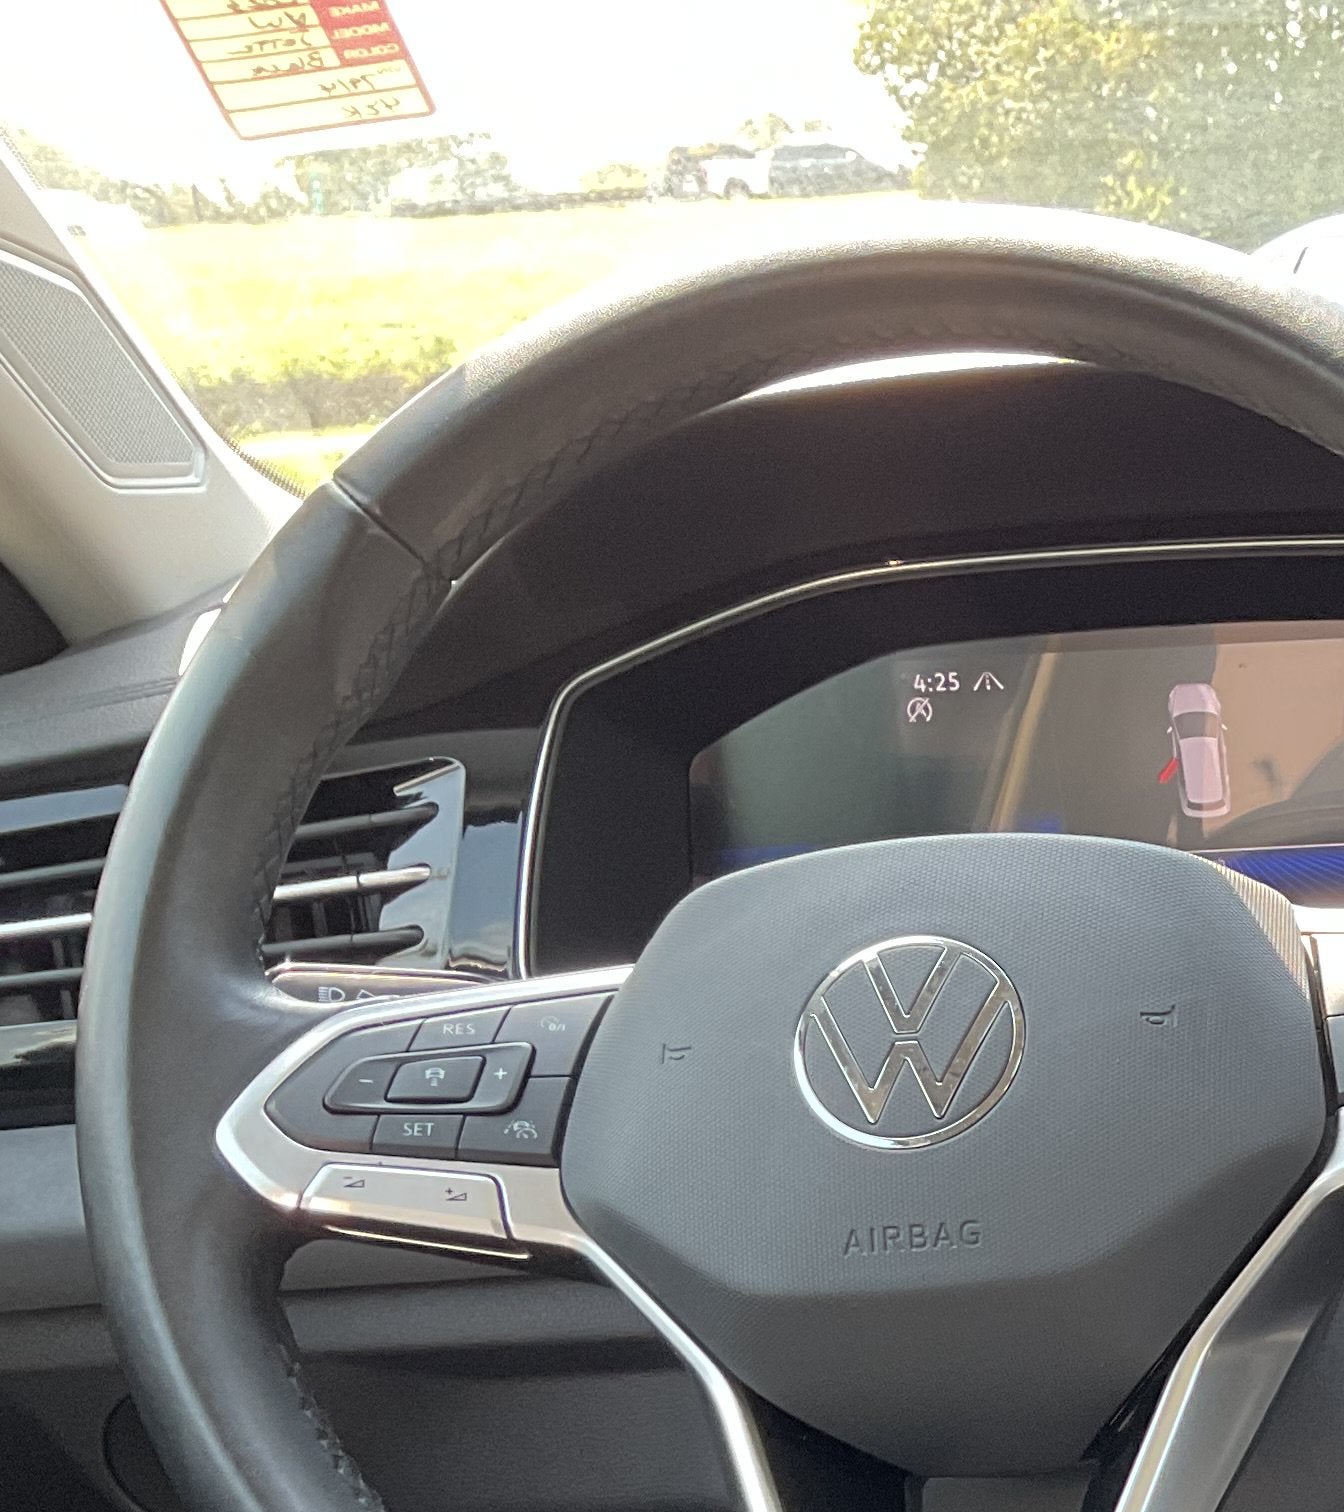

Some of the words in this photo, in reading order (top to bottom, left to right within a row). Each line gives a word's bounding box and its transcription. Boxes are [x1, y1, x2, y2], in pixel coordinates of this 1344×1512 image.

[913, 671, 961, 693] 4:25
[442, 1023, 476, 1035] RES
[806, 940, 1018, 1128] VW
[403, 1122, 434, 1137] SET
[842, 1219, 982, 1257] AIRBAG
